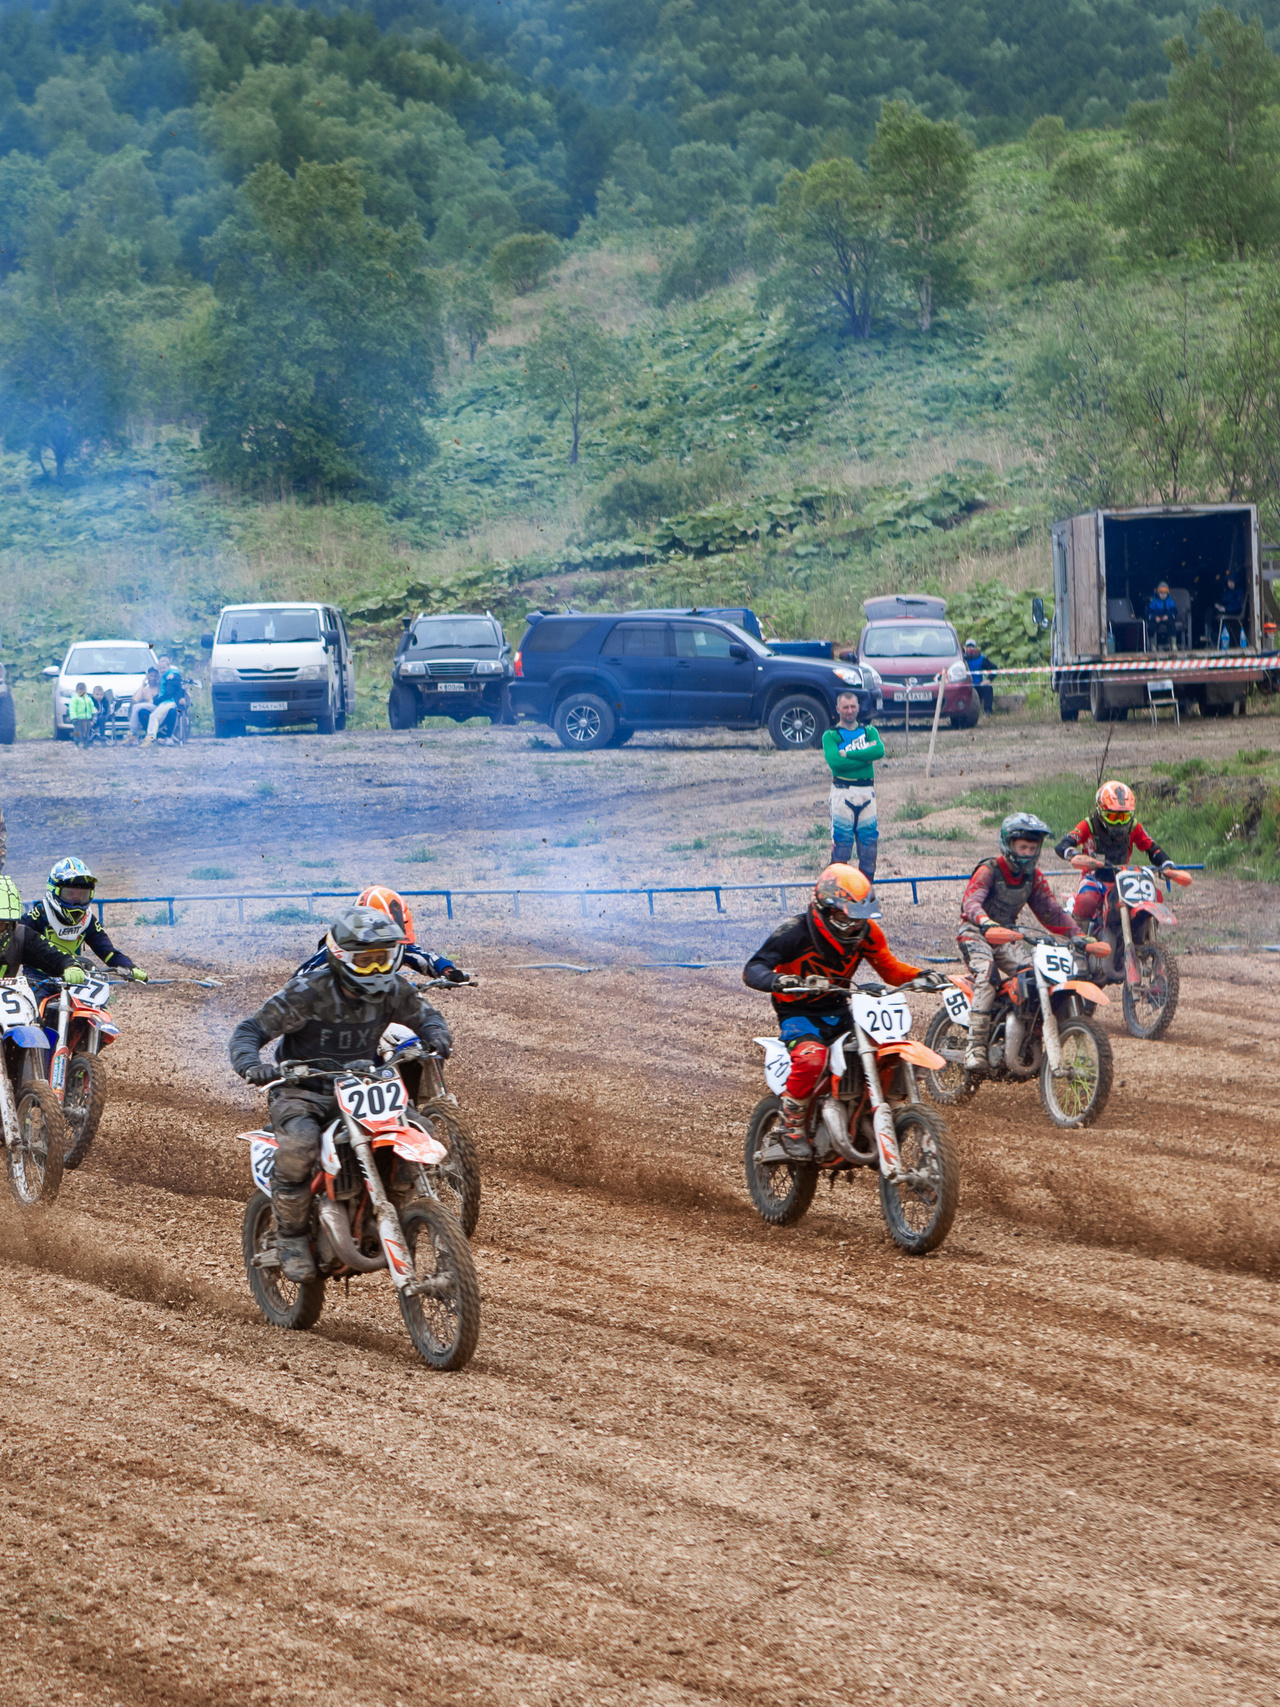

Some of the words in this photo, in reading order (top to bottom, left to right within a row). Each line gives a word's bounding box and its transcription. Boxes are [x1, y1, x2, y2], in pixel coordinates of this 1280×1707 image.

[1122, 877, 1156, 902] 29
[58, 926, 82, 937] LEATT
[1045, 954, 1072, 975] 56
[945, 992, 969, 1016] 56
[866, 1009, 904, 1033] 207
[320, 1028, 370, 1049] FOX
[347, 1082, 404, 1120] 202
